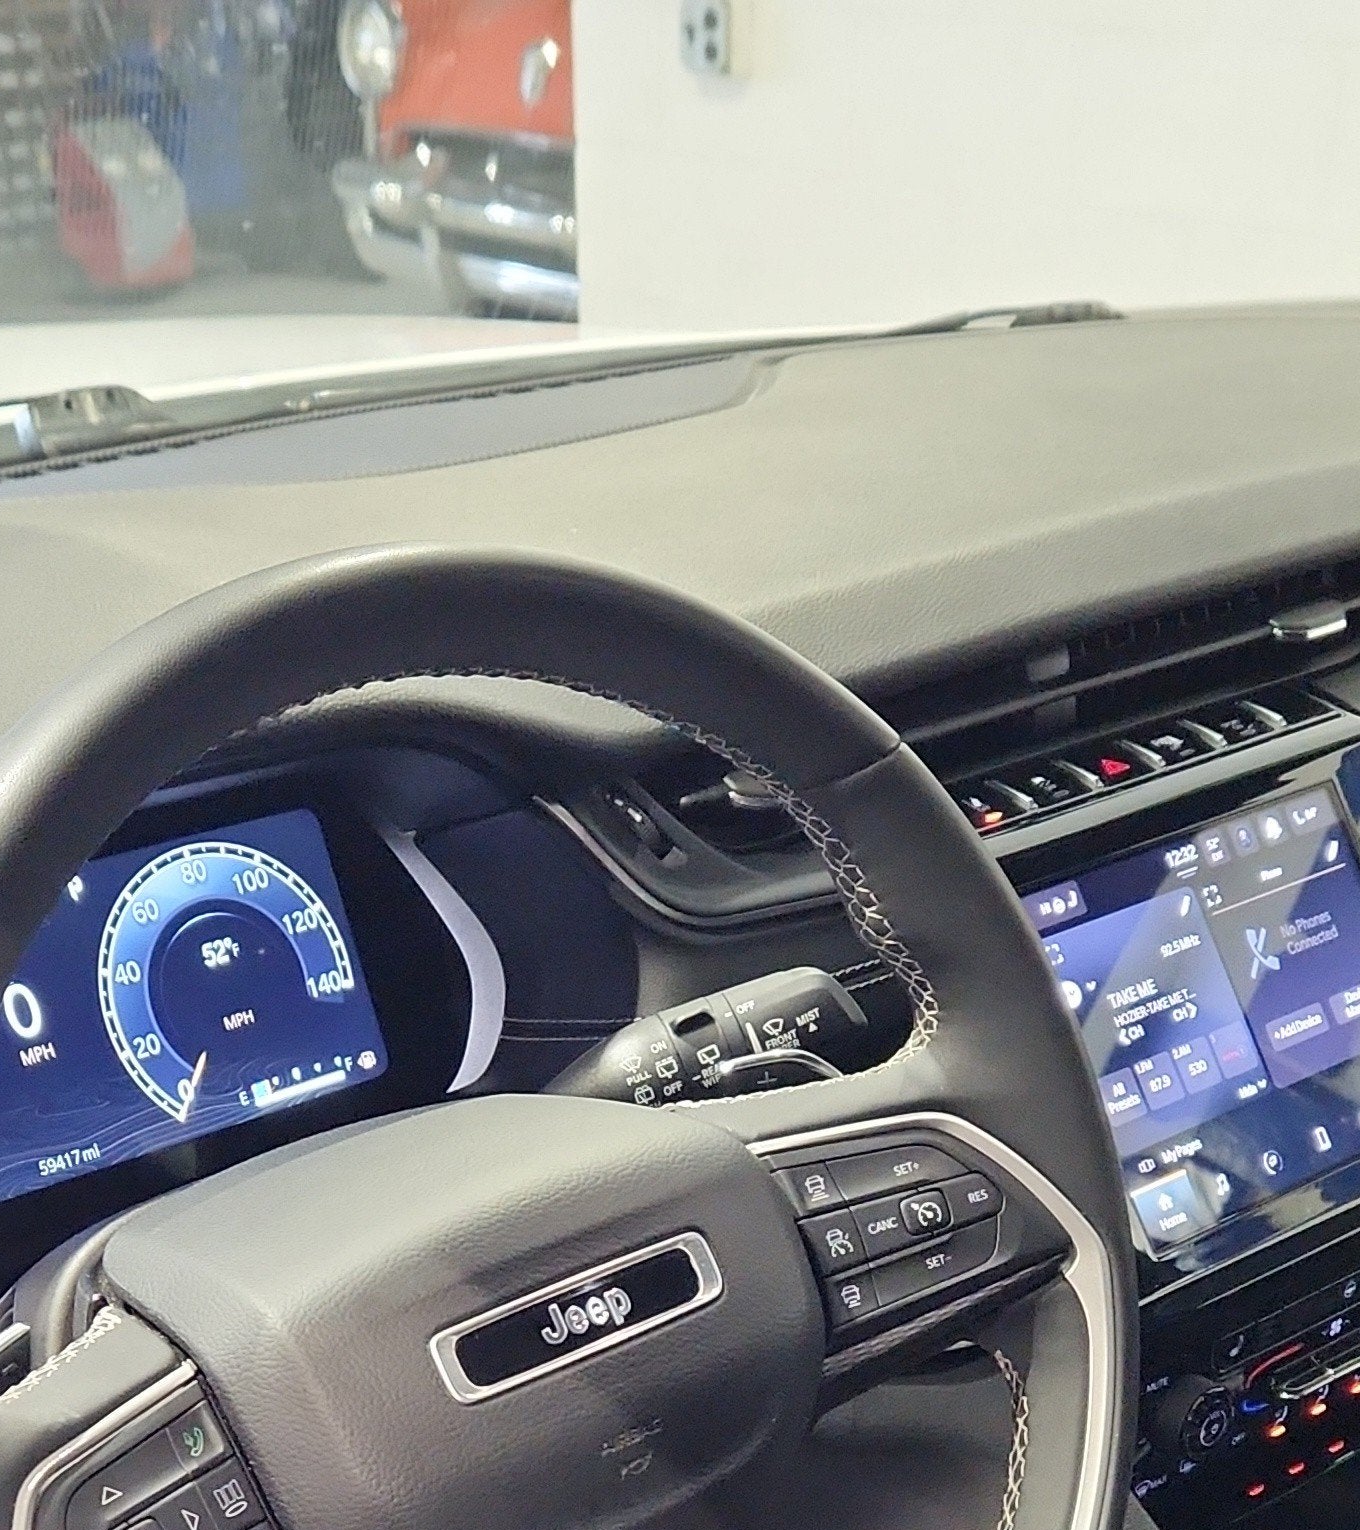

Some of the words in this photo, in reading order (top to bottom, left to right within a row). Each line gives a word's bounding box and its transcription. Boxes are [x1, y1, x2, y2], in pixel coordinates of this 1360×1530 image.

[181, 860, 207, 885] 80
[232, 867, 269, 895] 100
[132, 898, 159, 924] 60
[282, 908, 318, 935] 120
[1280, 923, 1296, 938] No
[1295, 911, 1332, 933] Phones
[1286, 924, 1339, 955] Connected
[114, 960, 141, 985] 40
[307, 970, 341, 998] 140
[1107, 985, 1140, 1009] TAKE
[1136, 978, 1159, 998] ME
[2, 982, 43, 1039] 0
[736, 1000, 756, 1014] OFF
[795, 1007, 820, 1027] MIST
[223, 1009, 255, 1030] MPH
[132, 1033, 161, 1060] 20
[650, 1040, 667, 1054] ON
[765, 1028, 797, 1050] FRONT
[19, 1042, 57, 1067] MPH
[345, 1056, 353, 1071] F
[177, 1079, 194, 1100] 0
[626, 1071, 652, 1086] PULL
[663, 1080, 683, 1096] OFF
[239, 1091, 250, 1106] E
[1108, 1094, 1141, 1114] Presets
[967, 1188, 989, 1204] RES
[867, 1216, 899, 1235] CANC
[541, 1287, 632, 1345] Jeep
